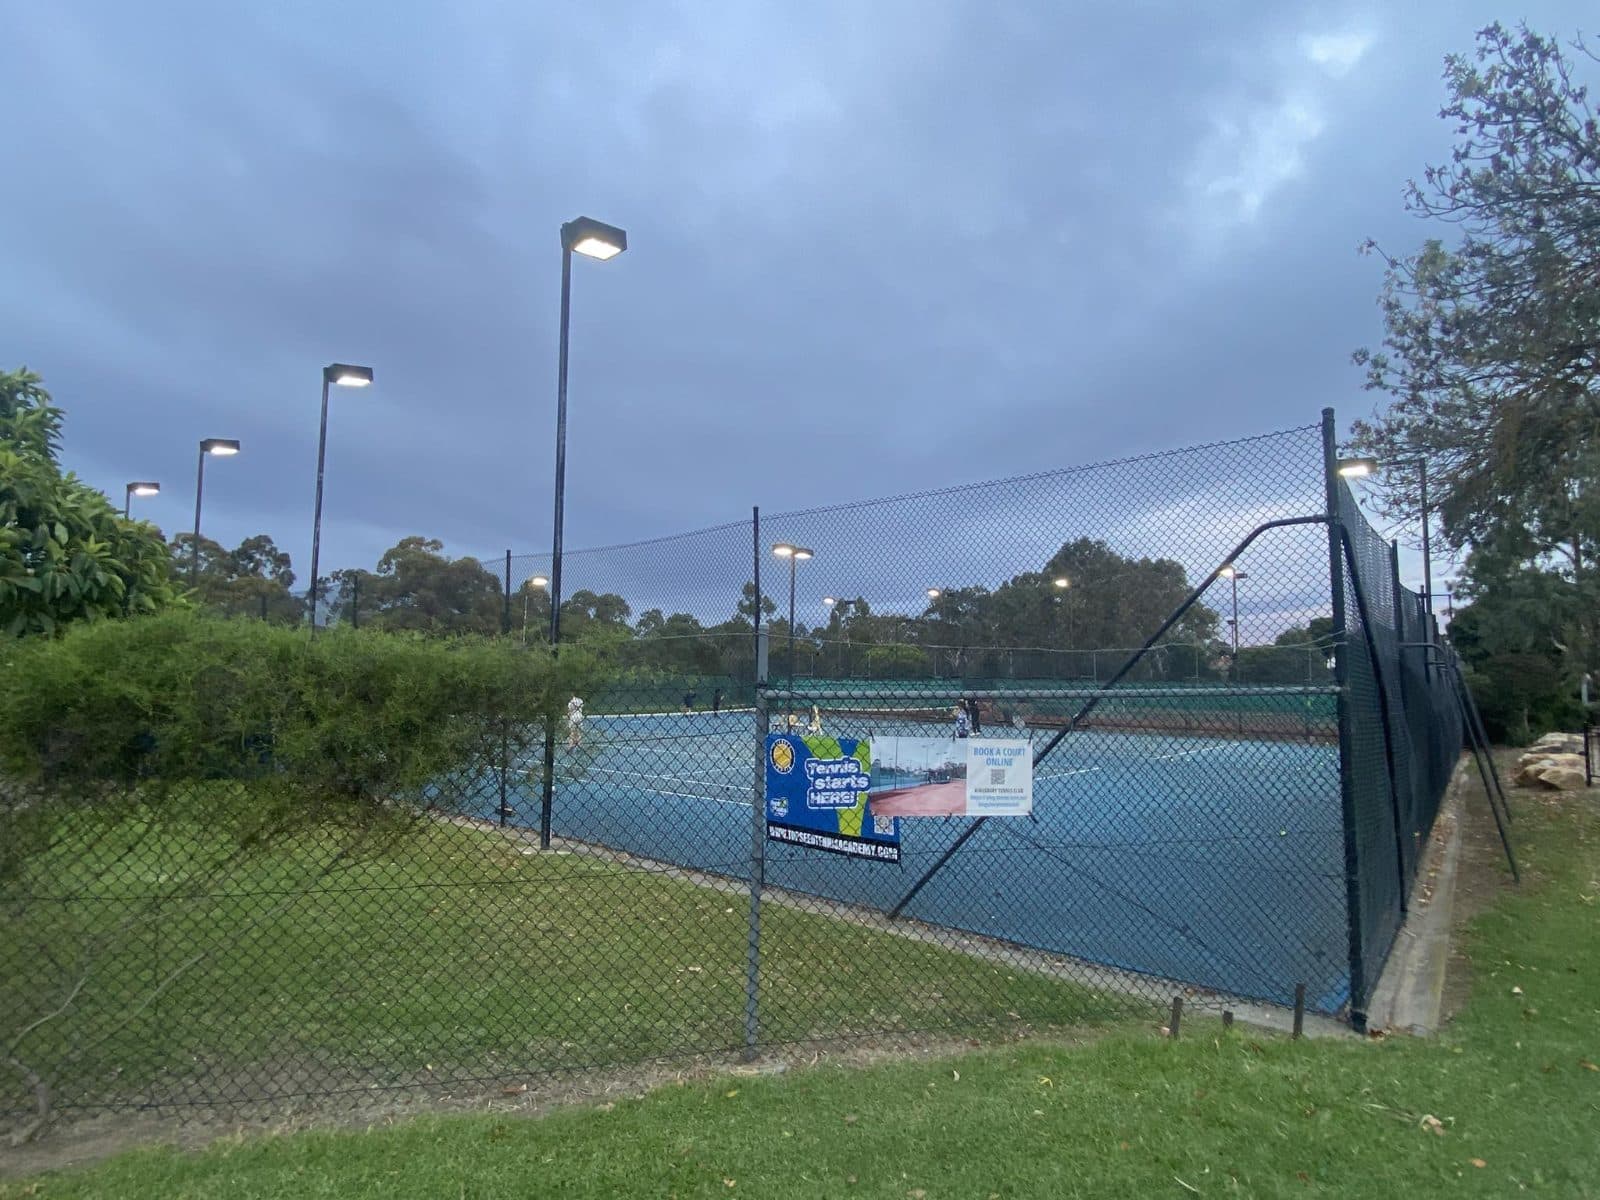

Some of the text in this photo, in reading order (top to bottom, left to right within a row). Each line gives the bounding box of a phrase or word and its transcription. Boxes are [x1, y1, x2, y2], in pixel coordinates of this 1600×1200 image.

[974, 747, 1025, 756] BOOK A COURT
[808, 761, 858, 774] Tennis
[986, 758, 1013, 766] ONLINE
[815, 775, 869, 789] starts
[810, 791, 855, 804] HERE!
